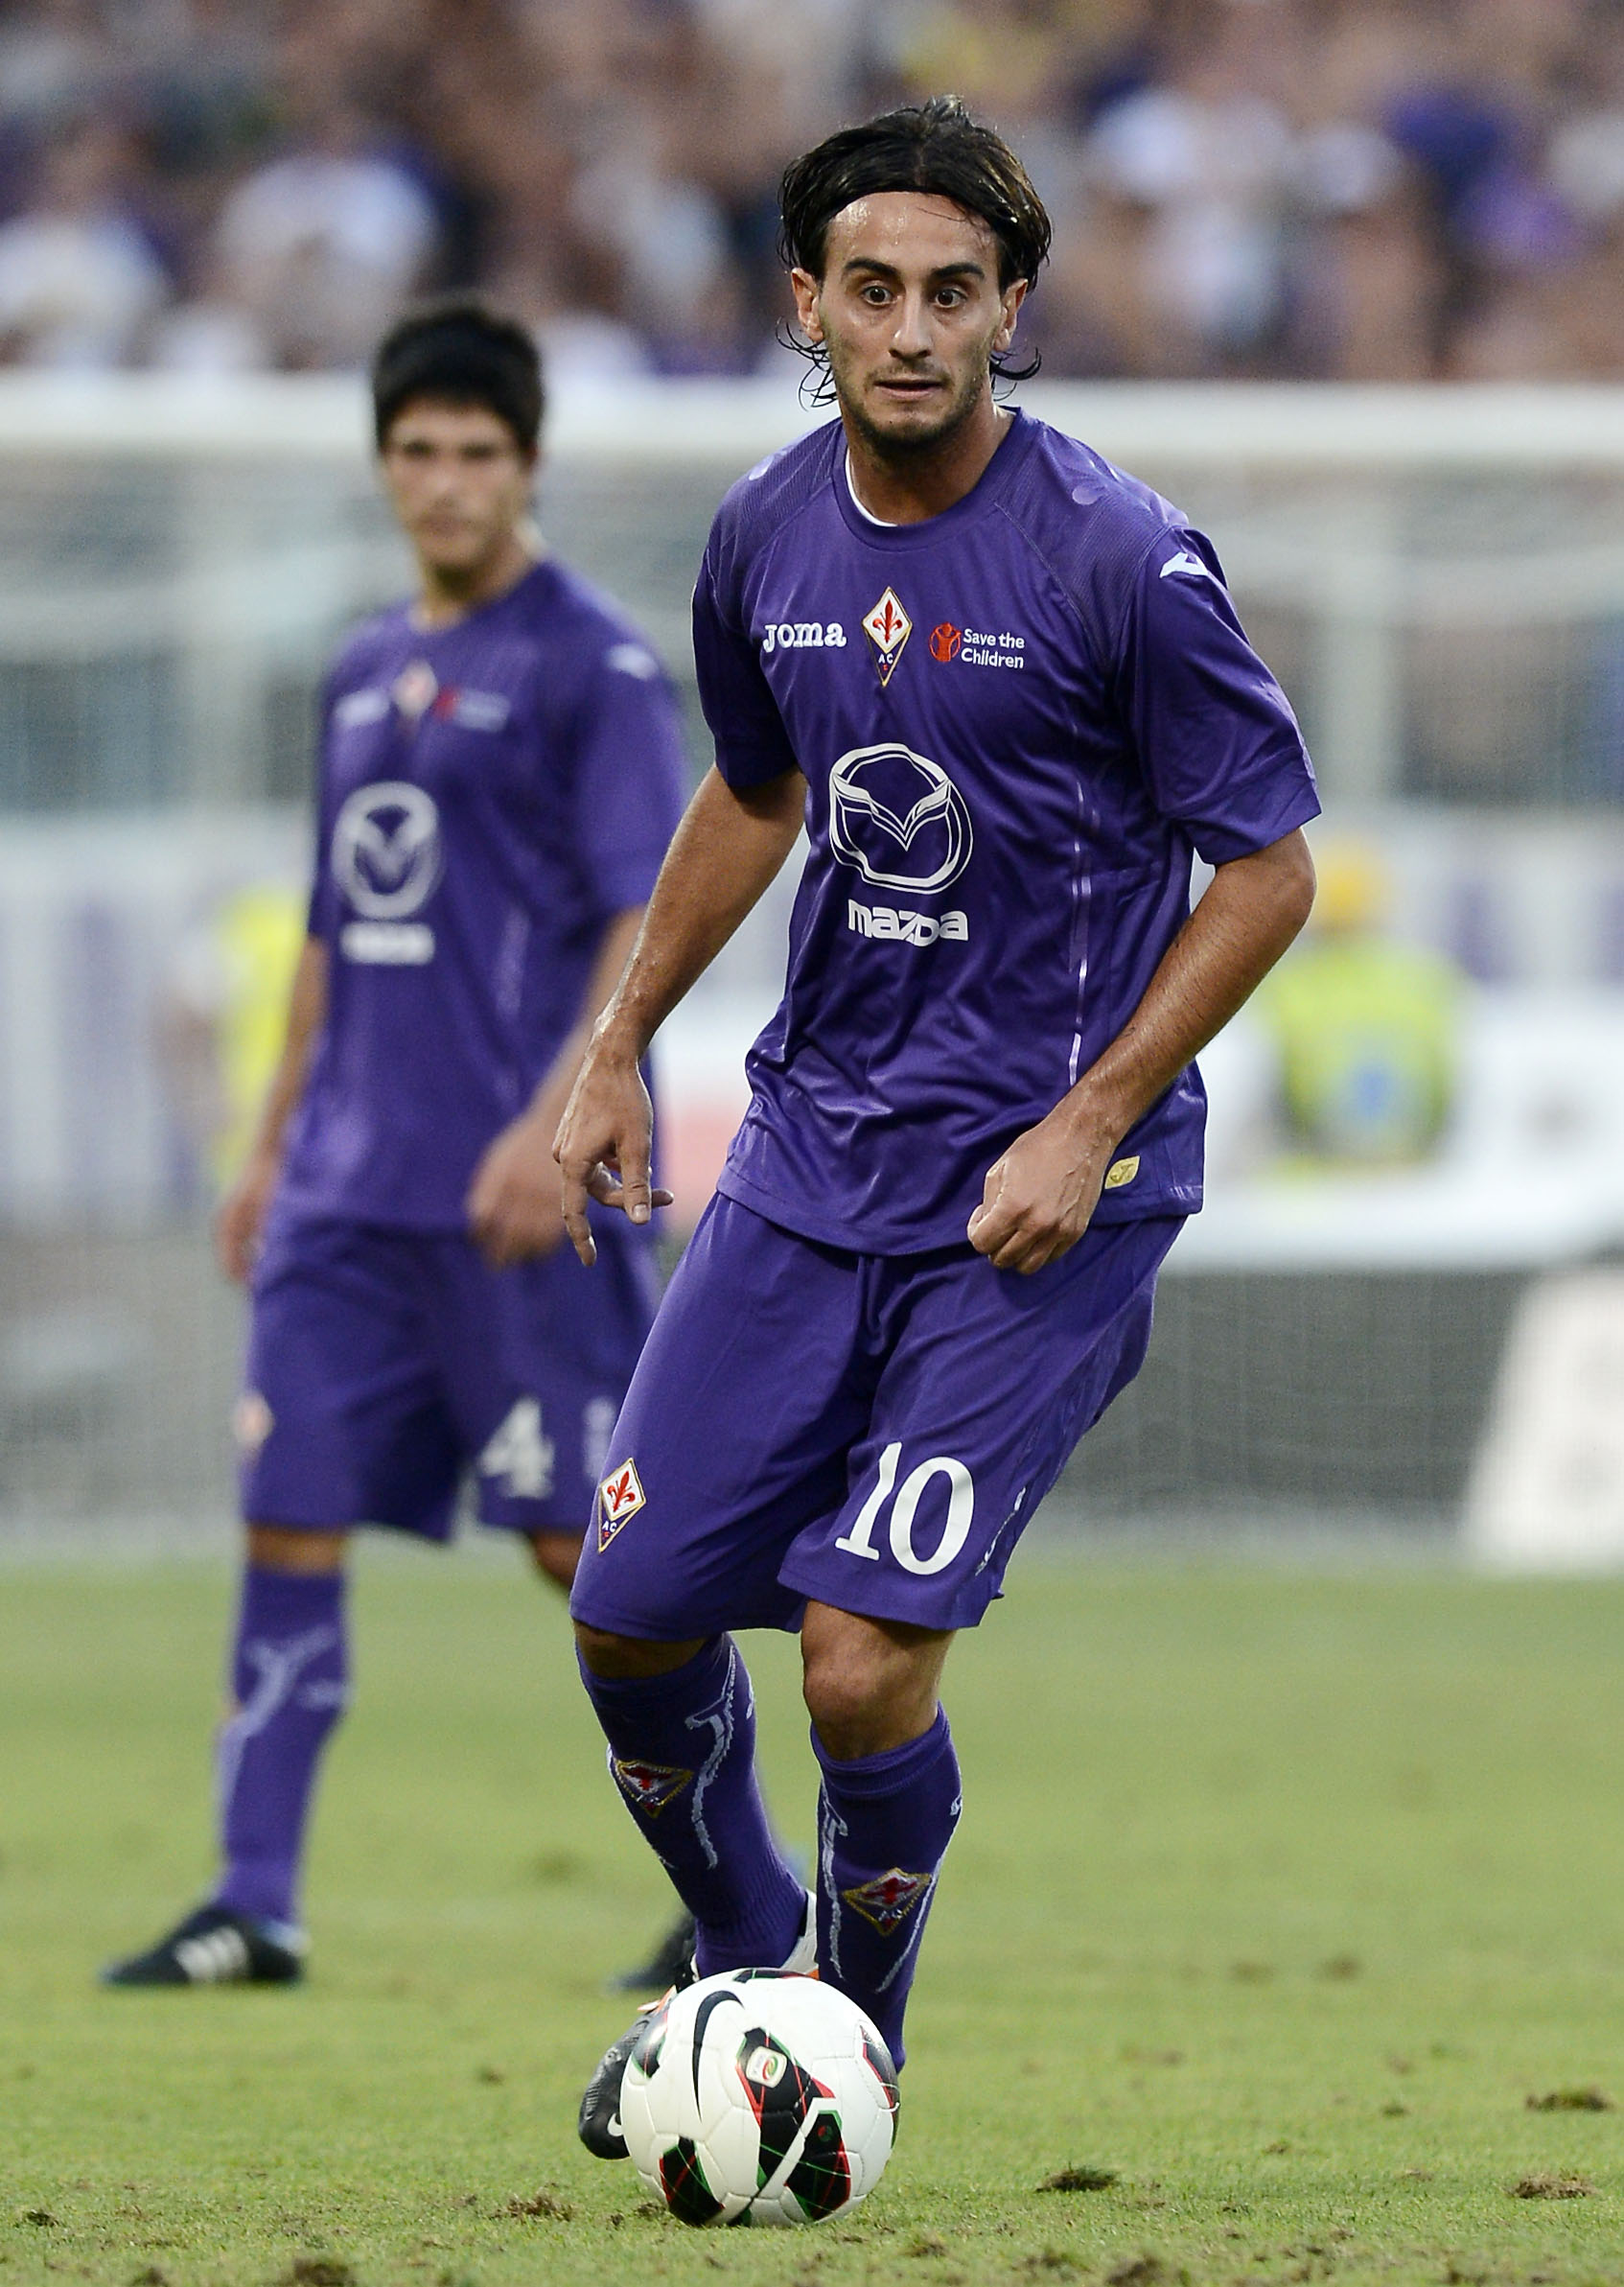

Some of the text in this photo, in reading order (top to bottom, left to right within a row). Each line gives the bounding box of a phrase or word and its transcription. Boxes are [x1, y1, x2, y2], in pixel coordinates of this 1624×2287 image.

[963, 628, 1025, 649] Save the
[961, 647, 1024, 669] Children
[835, 1441, 975, 1575] 10
